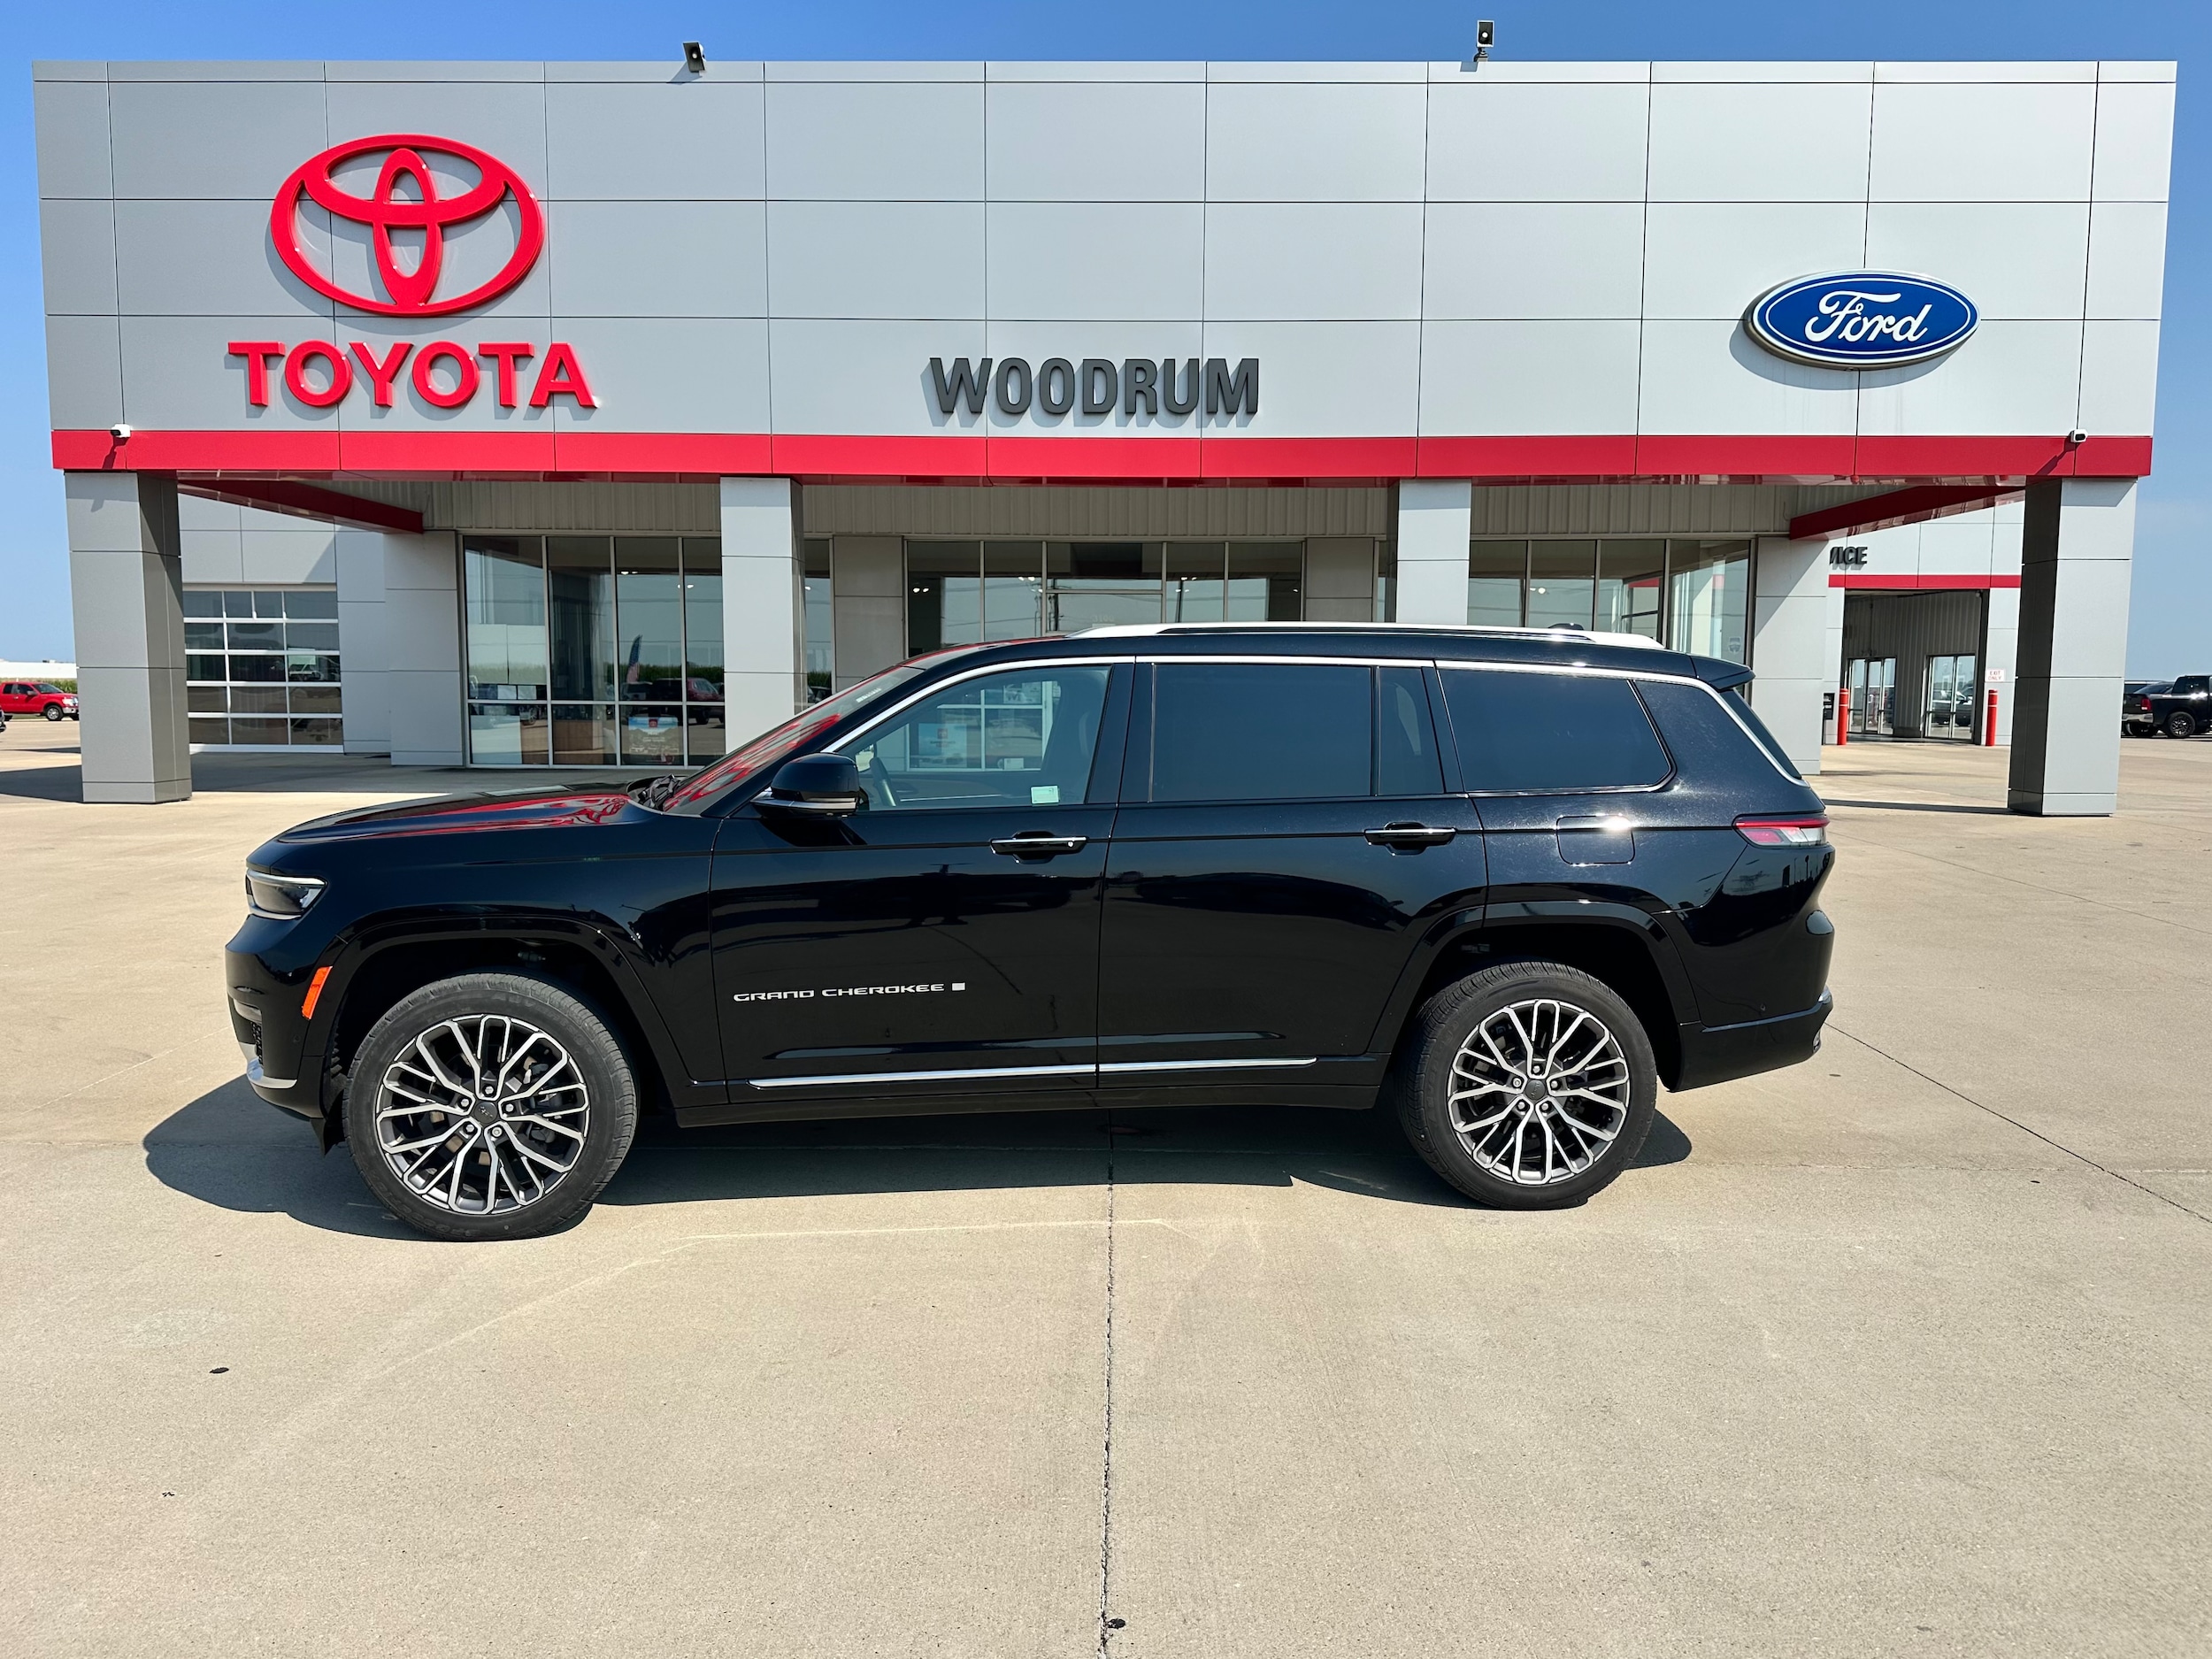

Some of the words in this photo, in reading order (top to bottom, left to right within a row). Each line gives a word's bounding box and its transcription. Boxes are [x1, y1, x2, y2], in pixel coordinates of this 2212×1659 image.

[1804, 289, 1933, 342] Ford
[227, 340, 599, 410] TOYOTA
[929, 357, 1260, 415] WOODRUM
[733, 989, 815, 1002] GRAND
[821, 983, 945, 997] CHEROKEE
